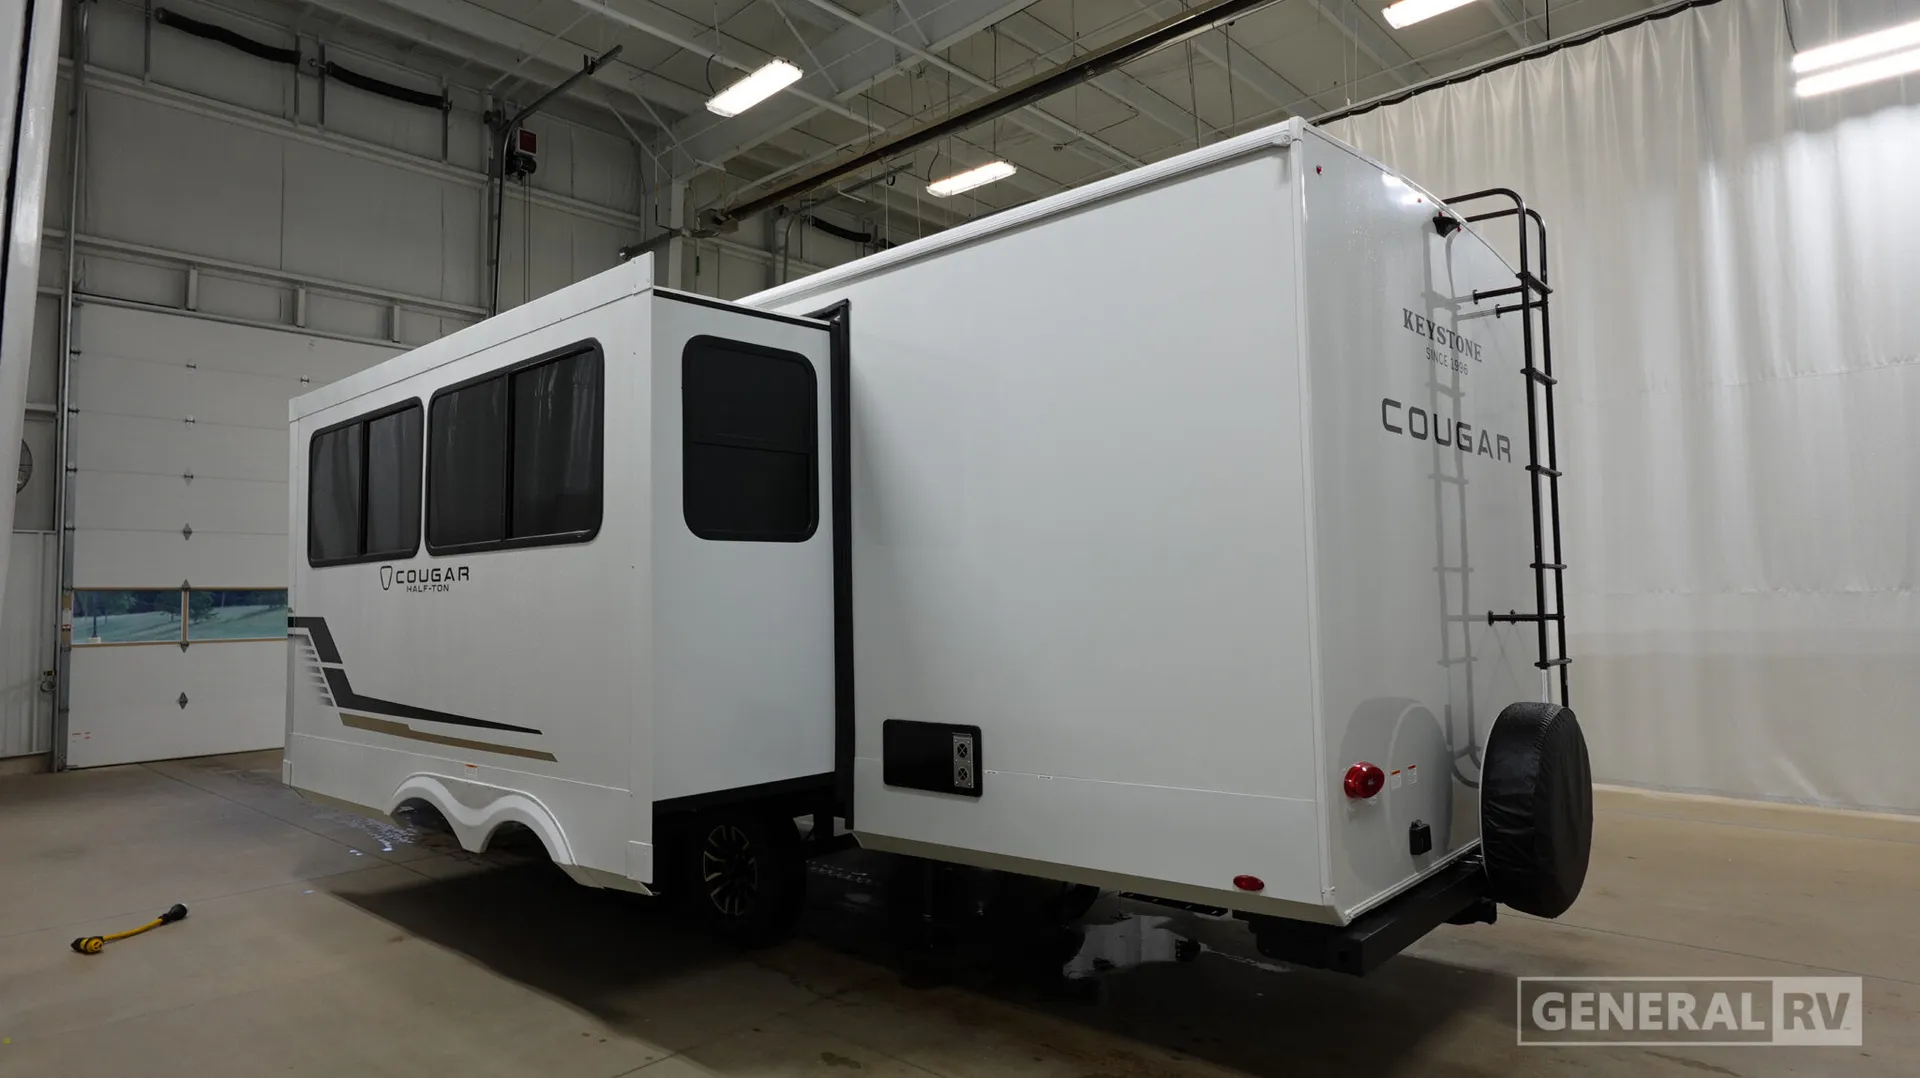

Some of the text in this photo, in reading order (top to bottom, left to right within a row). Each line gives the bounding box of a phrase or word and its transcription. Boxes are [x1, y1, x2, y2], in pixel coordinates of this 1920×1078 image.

[1402, 308, 1483, 363] KEYSTONE
[1426, 346, 1469, 376] SINCE 1996
[1381, 398, 1512, 464] COUGAR
[395, 566, 470, 584] COUGAR
[406, 584, 450, 593] HALF-TON
